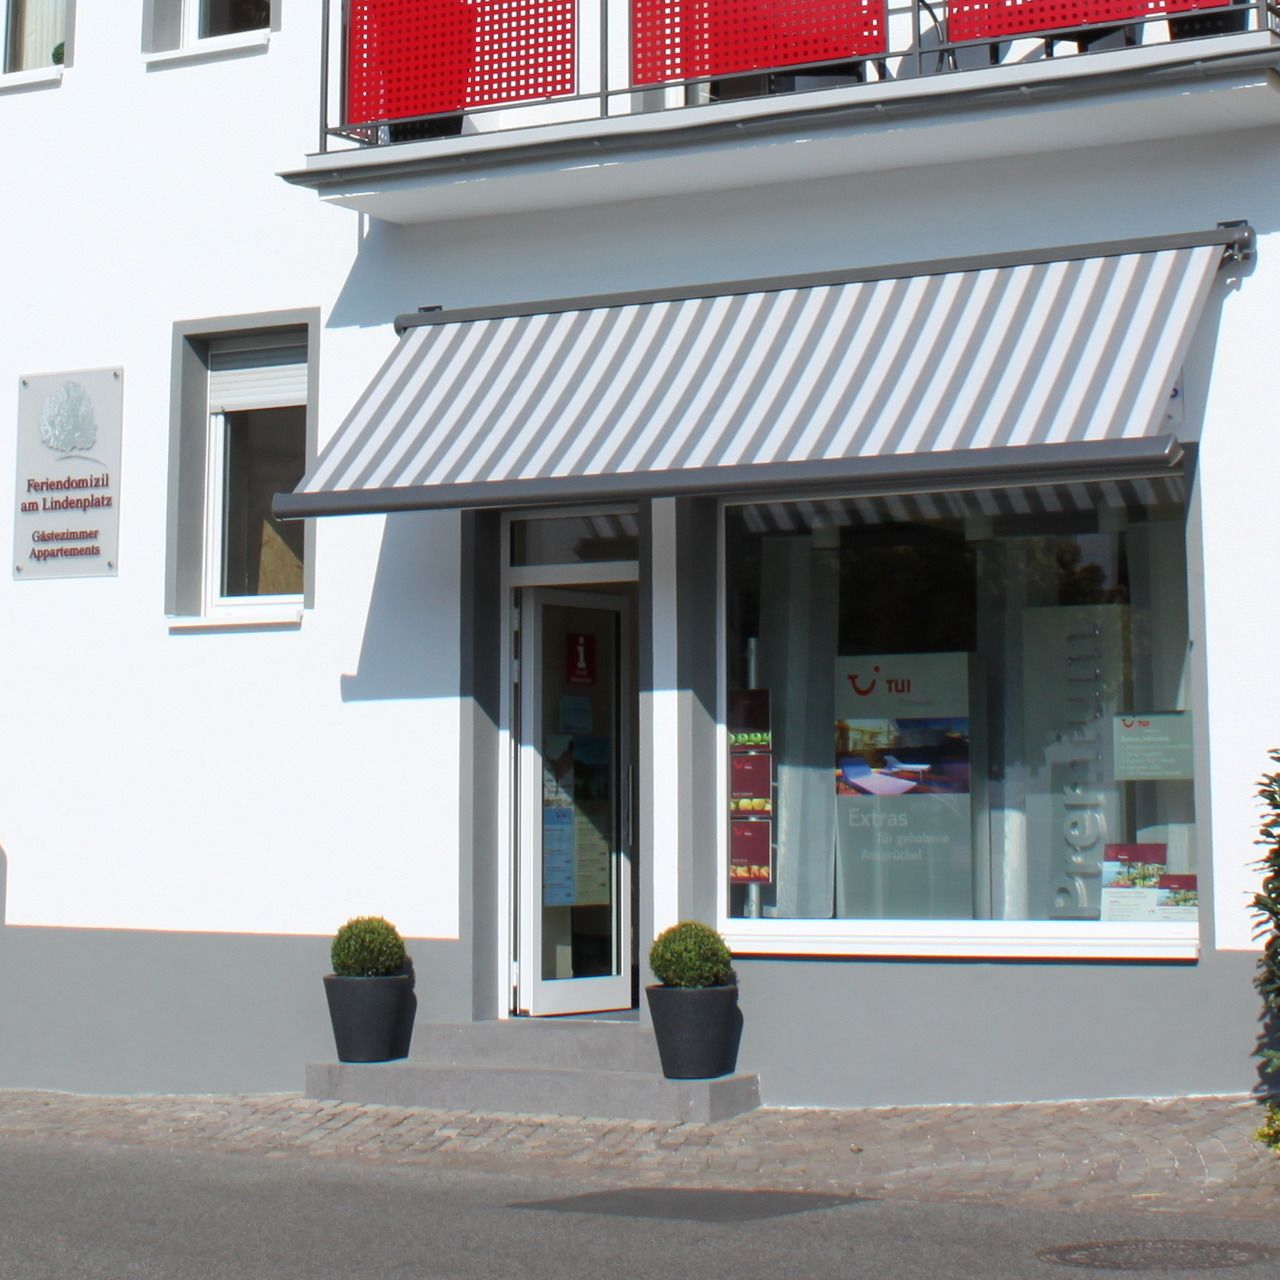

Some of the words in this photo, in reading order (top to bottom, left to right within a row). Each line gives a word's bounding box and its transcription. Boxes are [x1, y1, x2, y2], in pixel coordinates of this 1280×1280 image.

[26, 473, 109, 492] Feriendomizil
[20, 501, 39, 512] am
[42, 494, 113, 513] Lindenplatz
[31, 528, 99, 543] Gästezimmer
[28, 545, 101, 561] Appartements
[885, 678, 911, 693] TUI
[848, 807, 908, 827] Extras
